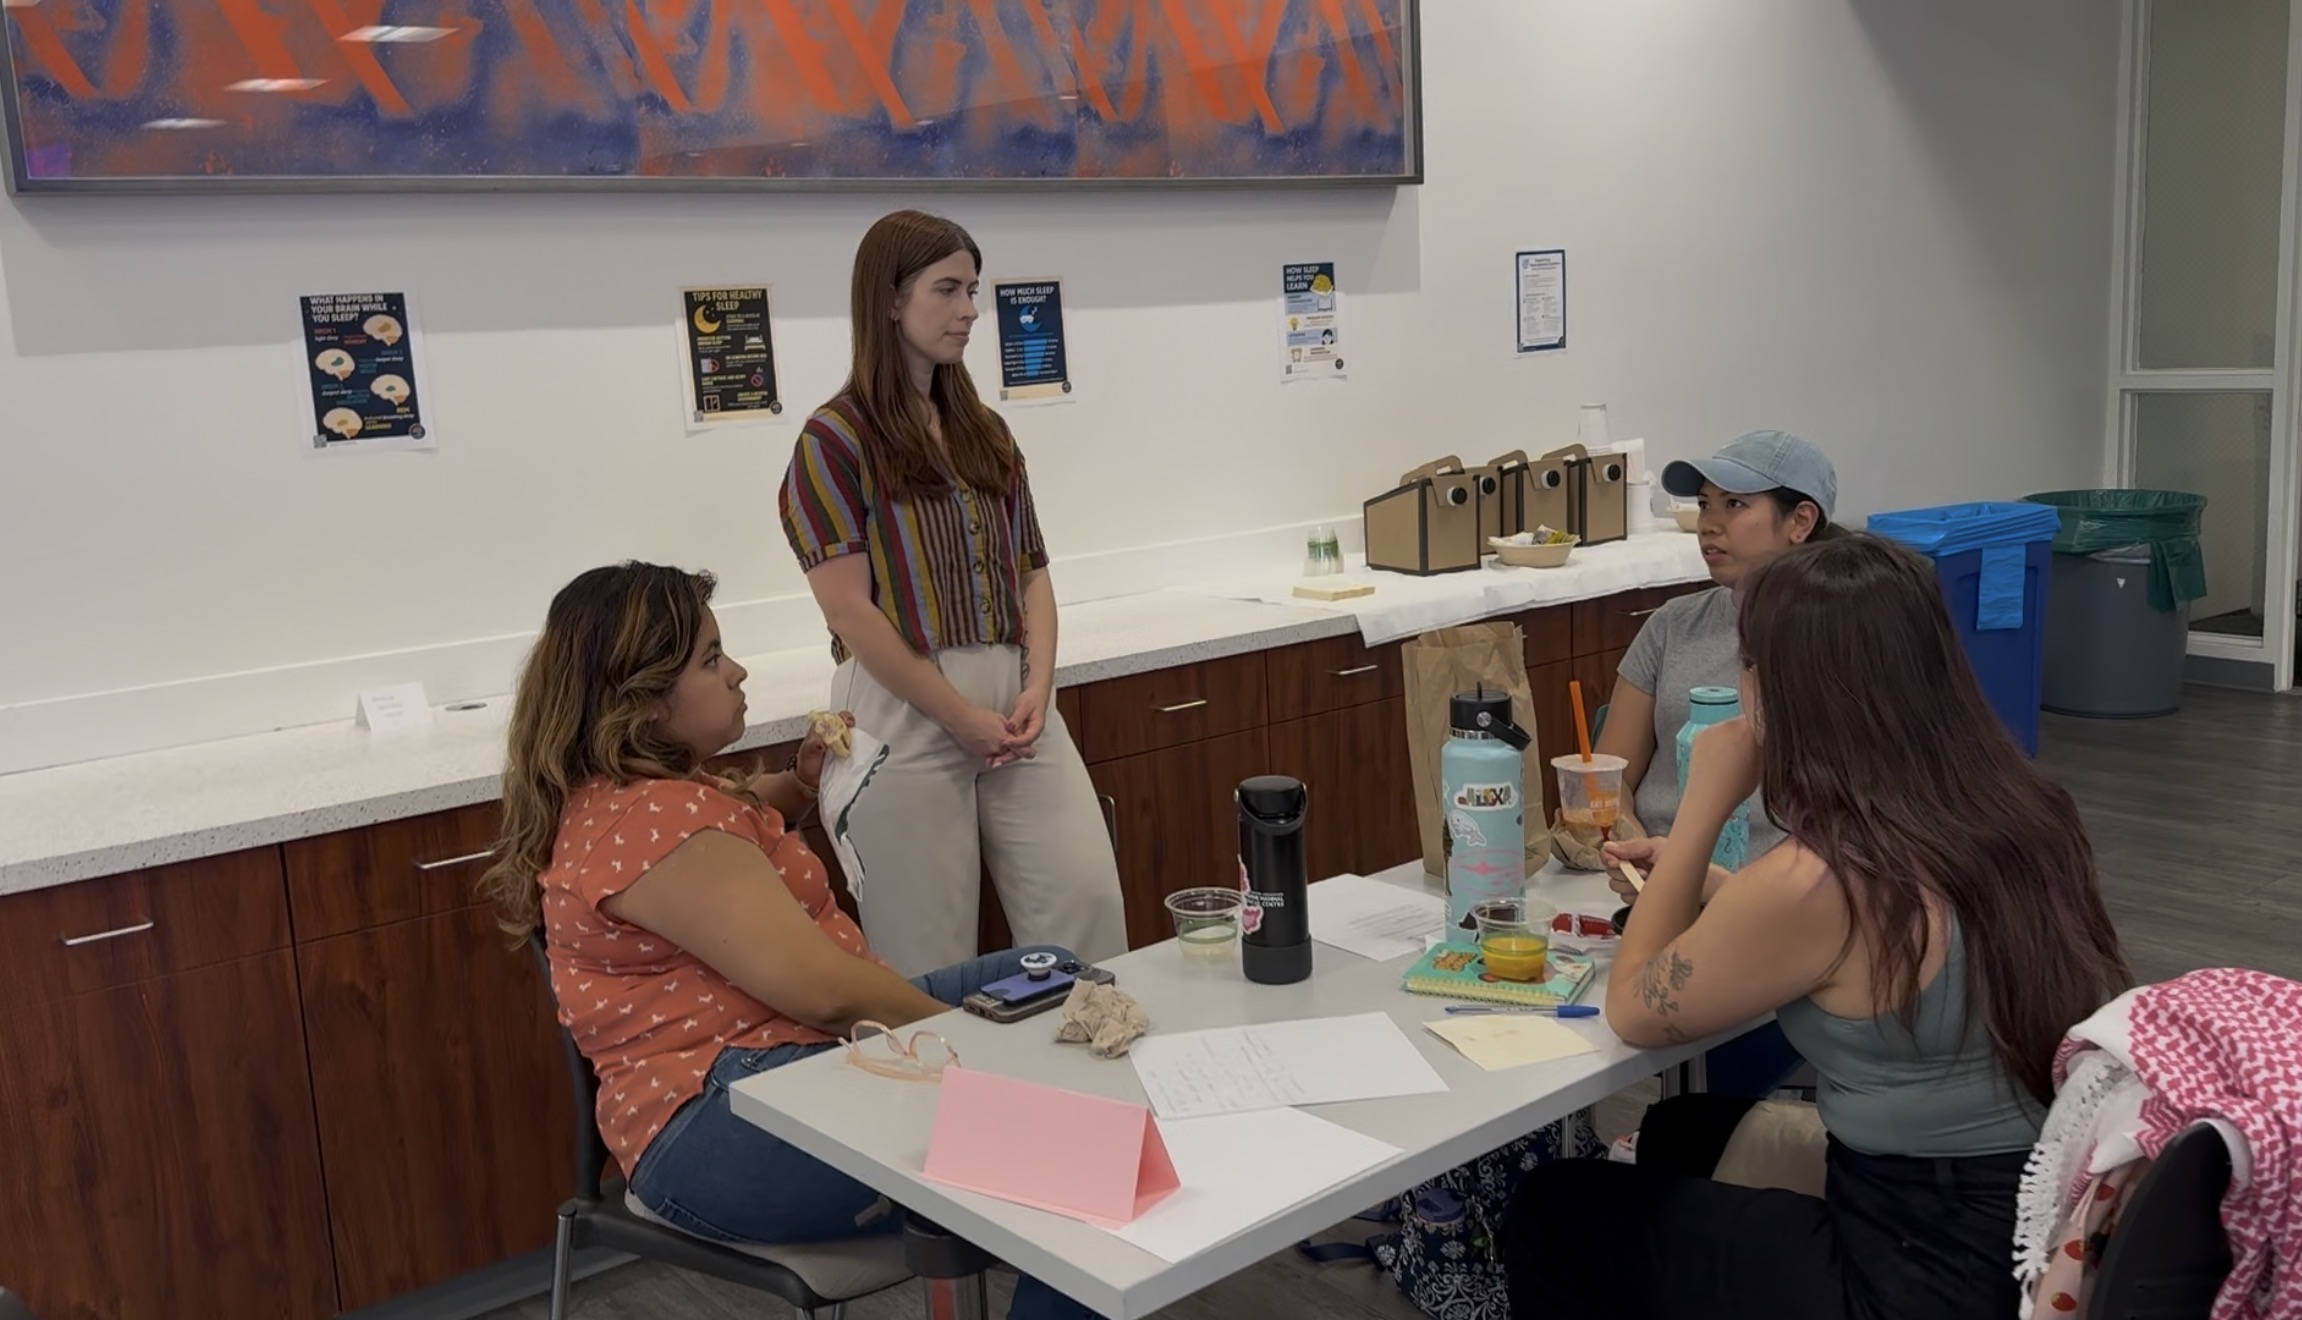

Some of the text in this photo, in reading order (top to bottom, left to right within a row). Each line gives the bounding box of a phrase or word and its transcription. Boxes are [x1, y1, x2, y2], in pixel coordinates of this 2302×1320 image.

[1000, 286, 1055, 297] HOW MUCH SLEEP
[1286, 282, 1308, 291] LEARN
[309, 294, 384, 305] WHAT HAPPENS IN
[692, 290, 762, 302] TIPS FOR HEALTHY
[1010, 295, 1047, 305] IS ENOUGH?
[311, 302, 387, 314] YOUR BRAIN WHILE
[716, 301, 740, 311] SLEEP
[312, 313, 359, 323] YOU SLEEP?
